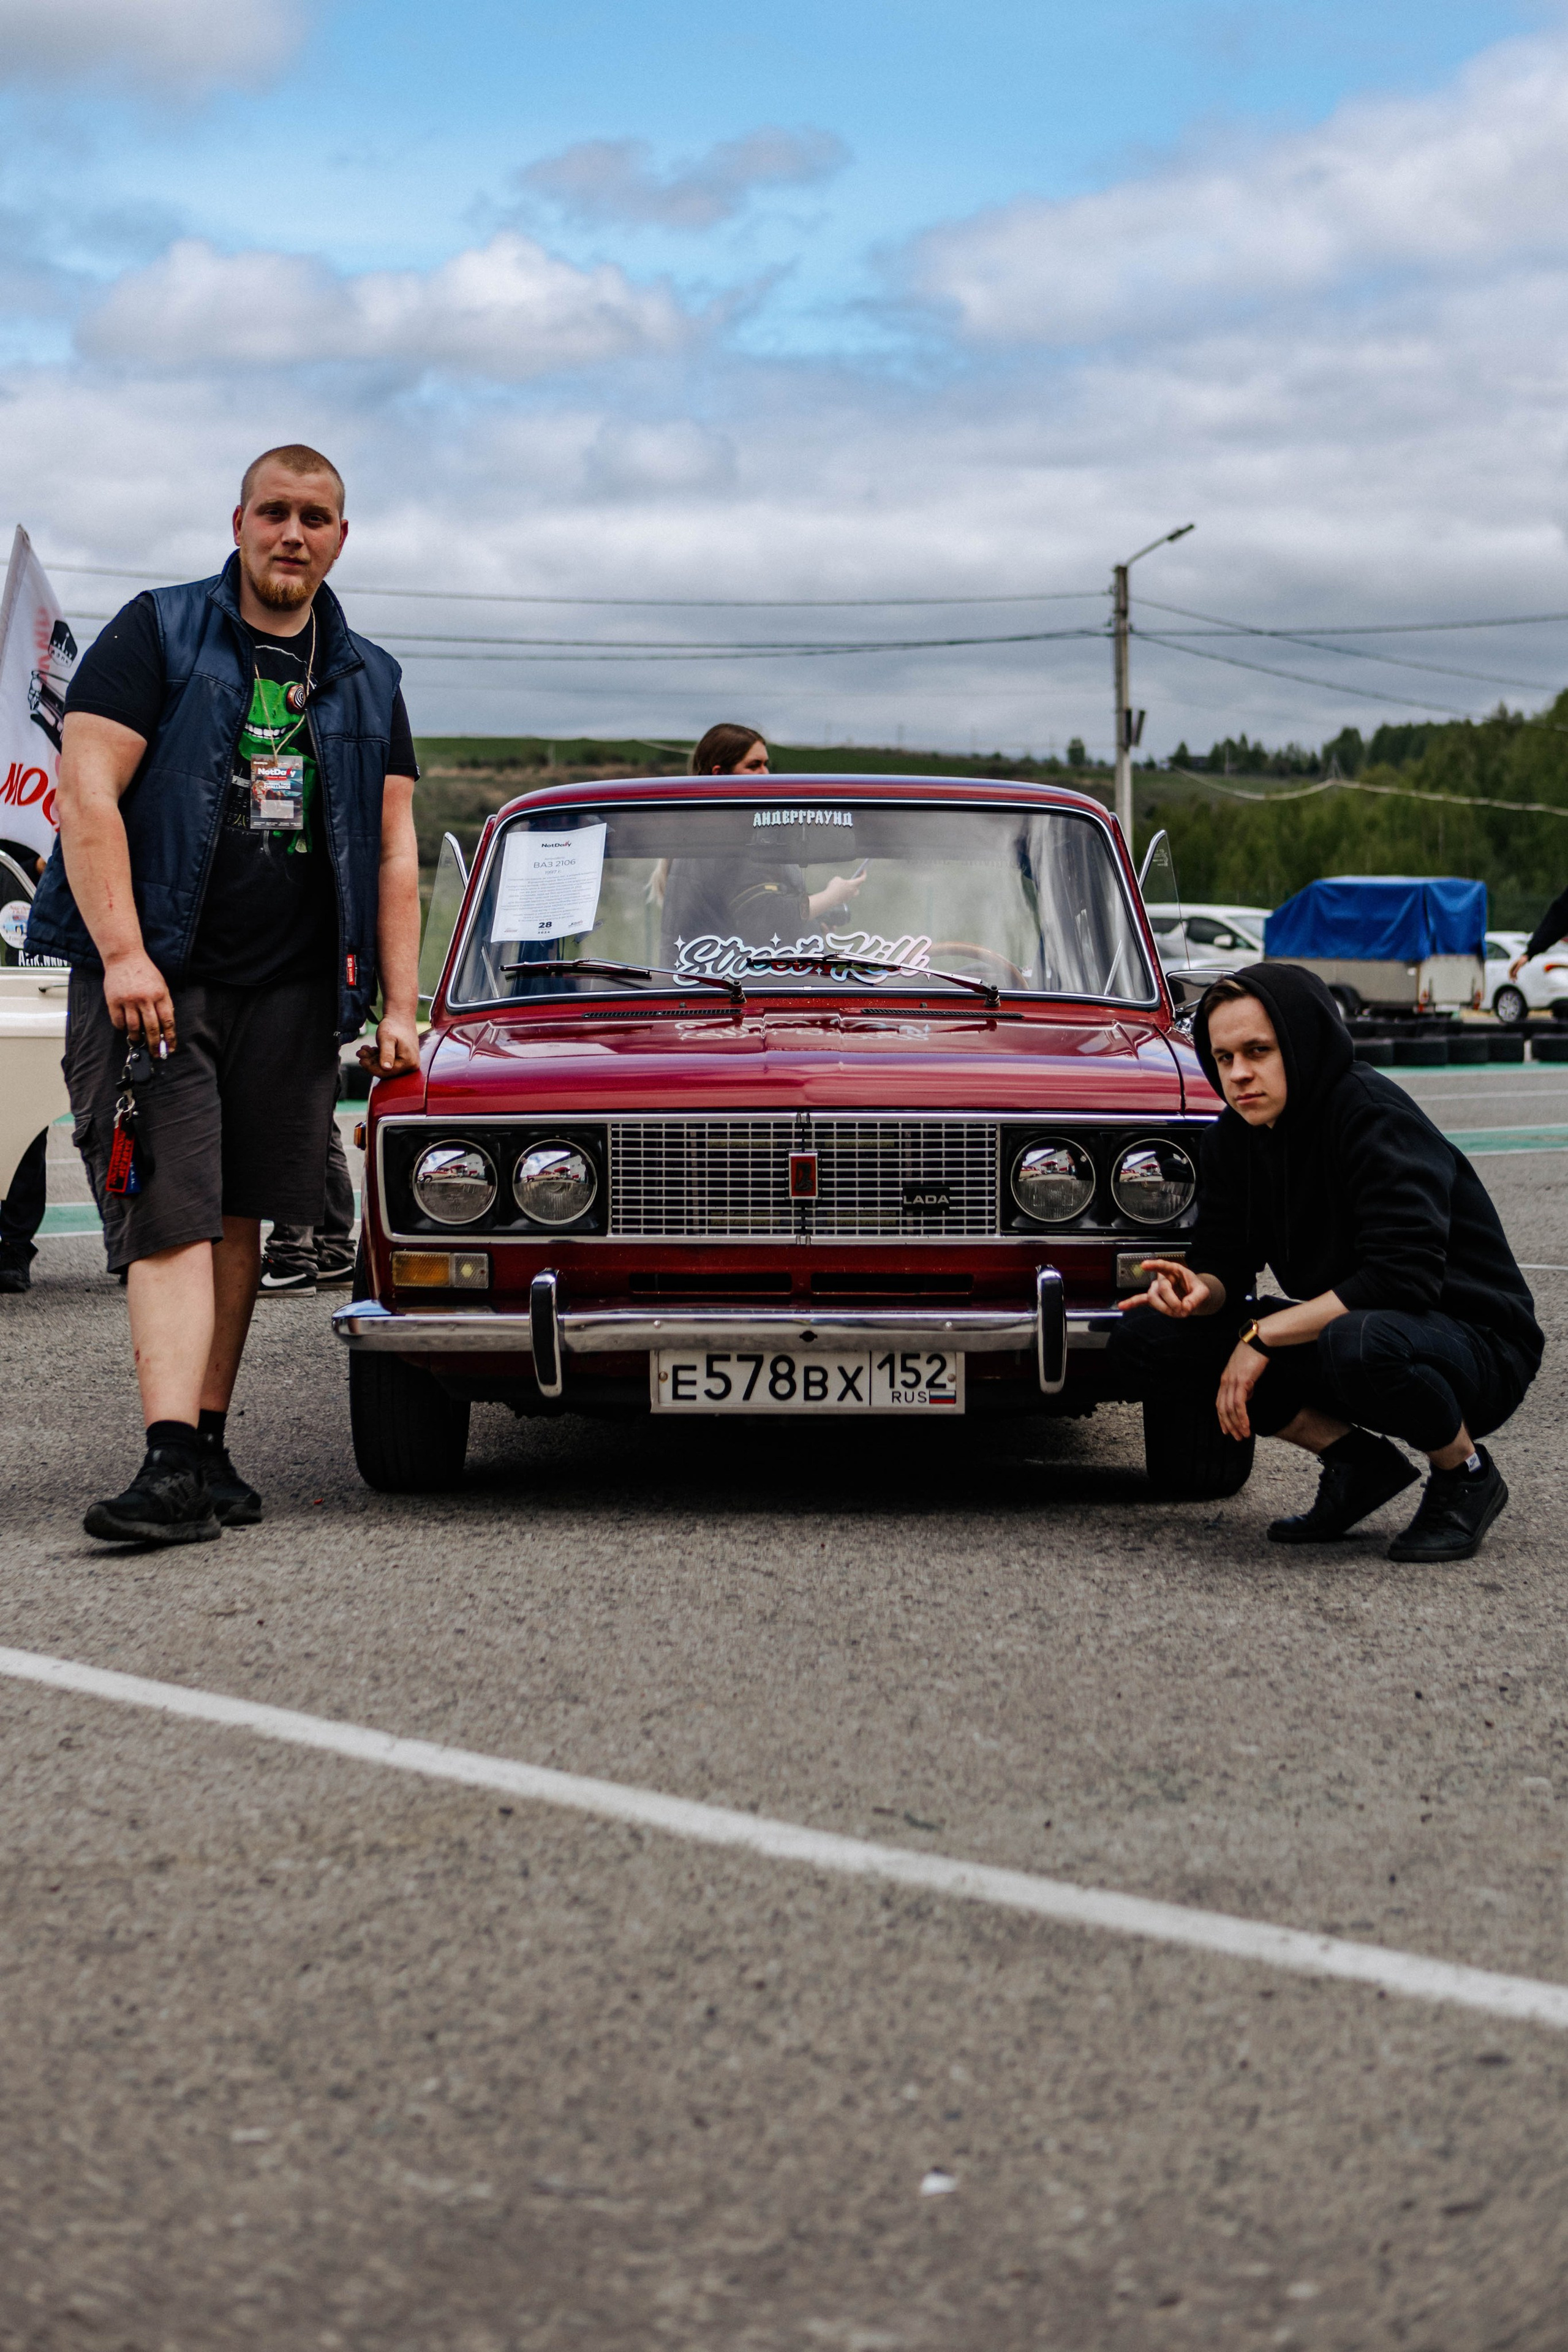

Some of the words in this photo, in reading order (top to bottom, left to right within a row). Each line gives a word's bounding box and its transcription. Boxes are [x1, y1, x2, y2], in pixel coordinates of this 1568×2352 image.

[753, 809, 853, 827] АНДЕРГРАУНД
[556, 859, 576, 867] 2106
[903, 1195, 949, 1204] LADA
[877, 1353, 947, 1389] 152
[892, 1390, 927, 1403] RUS
